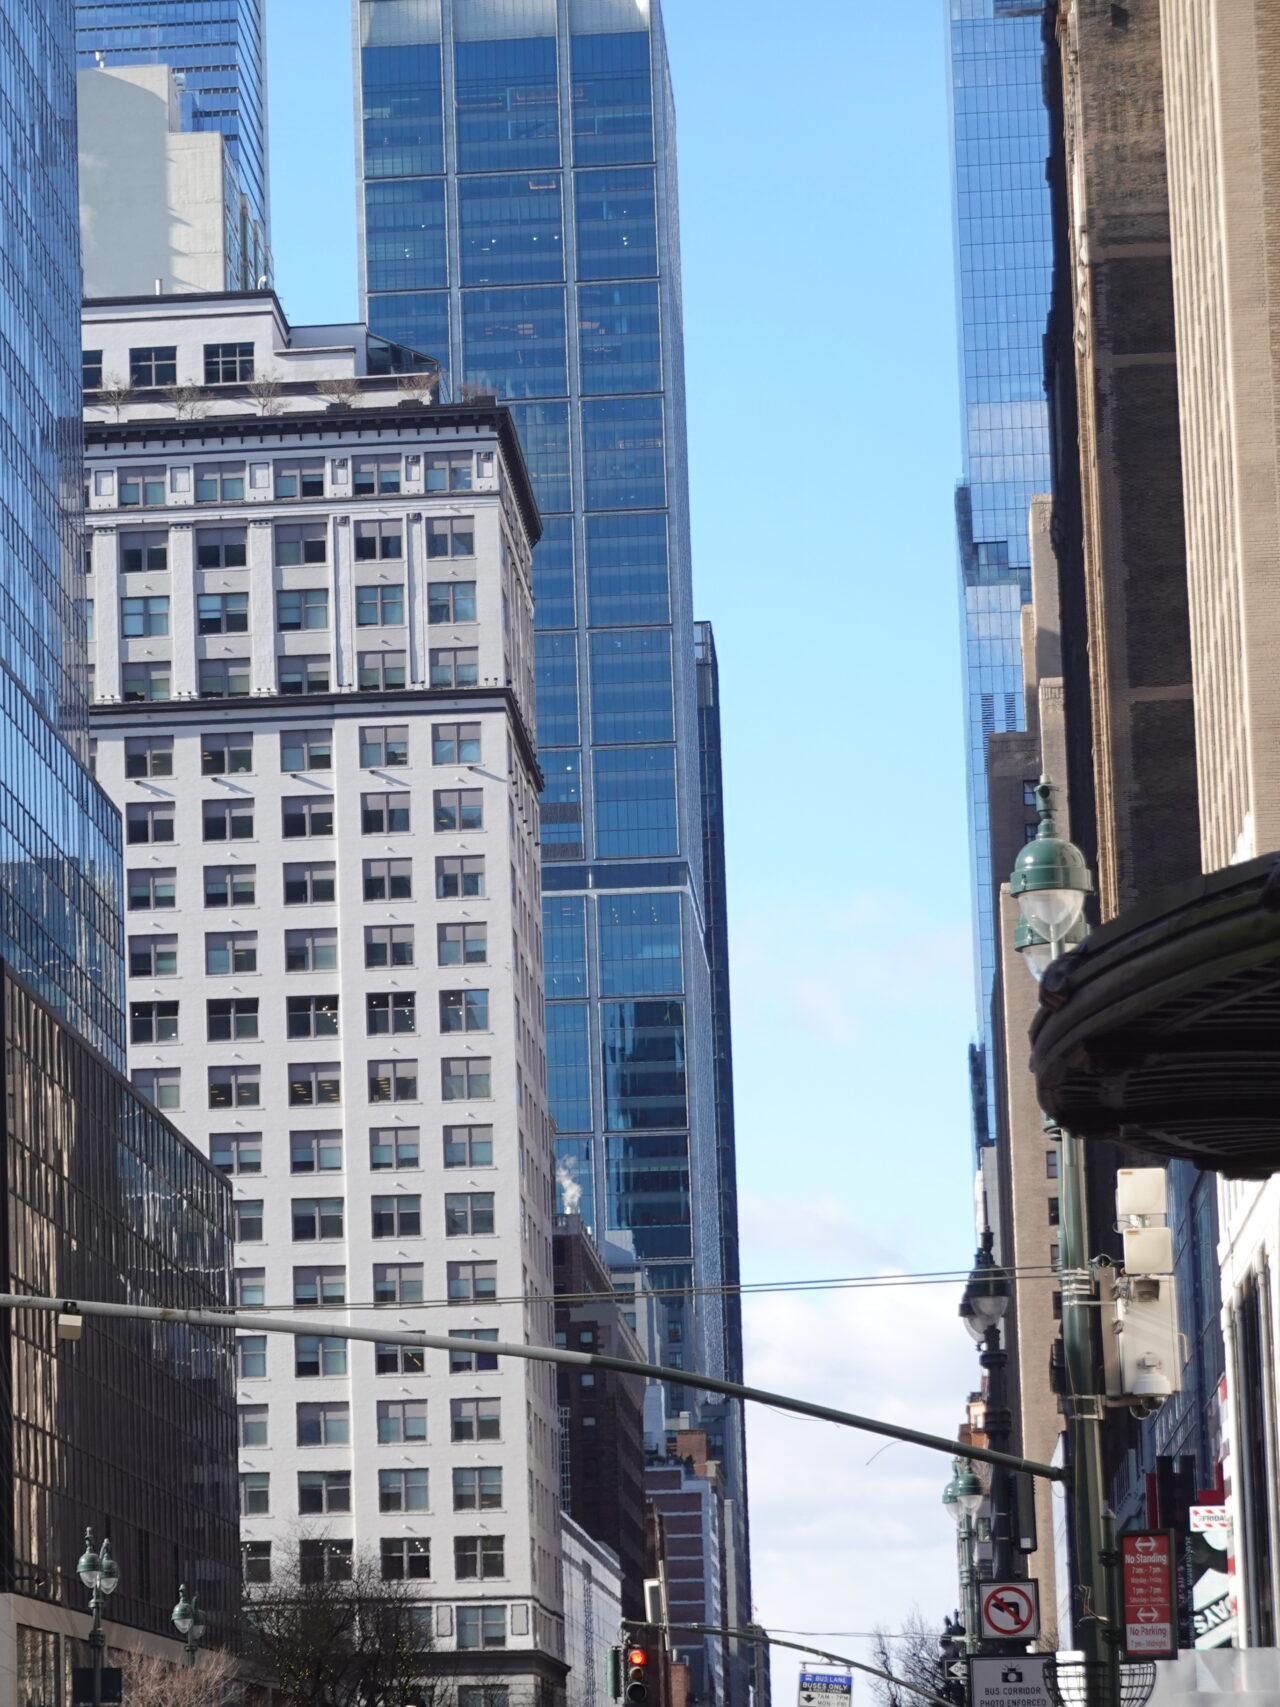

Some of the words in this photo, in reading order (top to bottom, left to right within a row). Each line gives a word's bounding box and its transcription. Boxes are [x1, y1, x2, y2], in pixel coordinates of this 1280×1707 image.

[1124, 1554, 1136, 1565] No
[1136, 1552, 1168, 1565] Standing
[1129, 1626, 1139, 1636] No
[1140, 1625, 1167, 1638] Parking
[984, 1687, 1000, 1696] BUS
[1002, 1686, 1042, 1696] CORRIDOR
[979, 1699, 1005, 1707] PHOTO
[1007, 1698, 1047, 1707] ENFORCED
